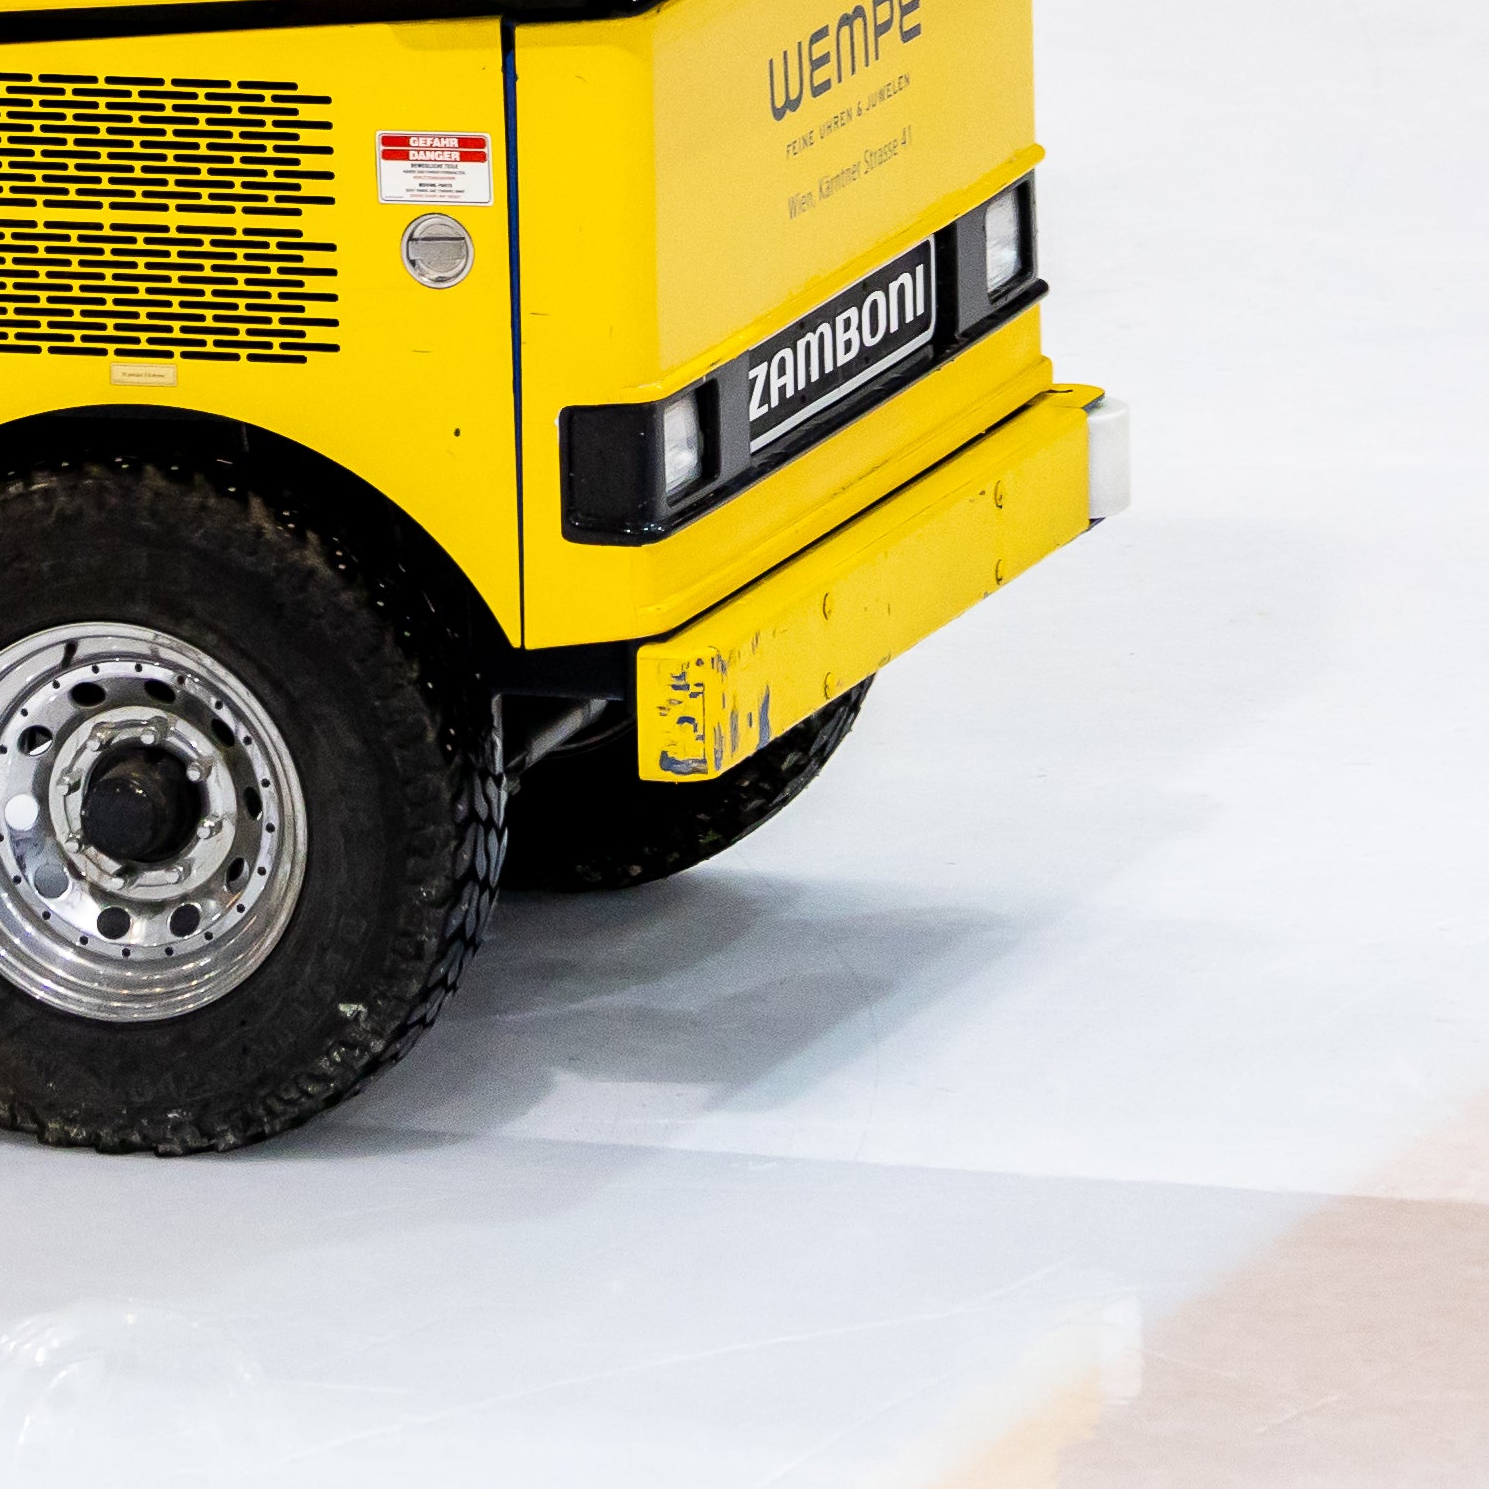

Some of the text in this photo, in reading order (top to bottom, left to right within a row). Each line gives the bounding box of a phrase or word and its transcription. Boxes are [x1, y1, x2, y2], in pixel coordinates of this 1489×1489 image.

[785, 71, 911, 159] FEINE UHREN & JUWELEN
[408, 136, 459, 148] GEFAHR
[408, 150, 461, 161] DANGER
[748, 263, 925, 422] ZAMBONI
